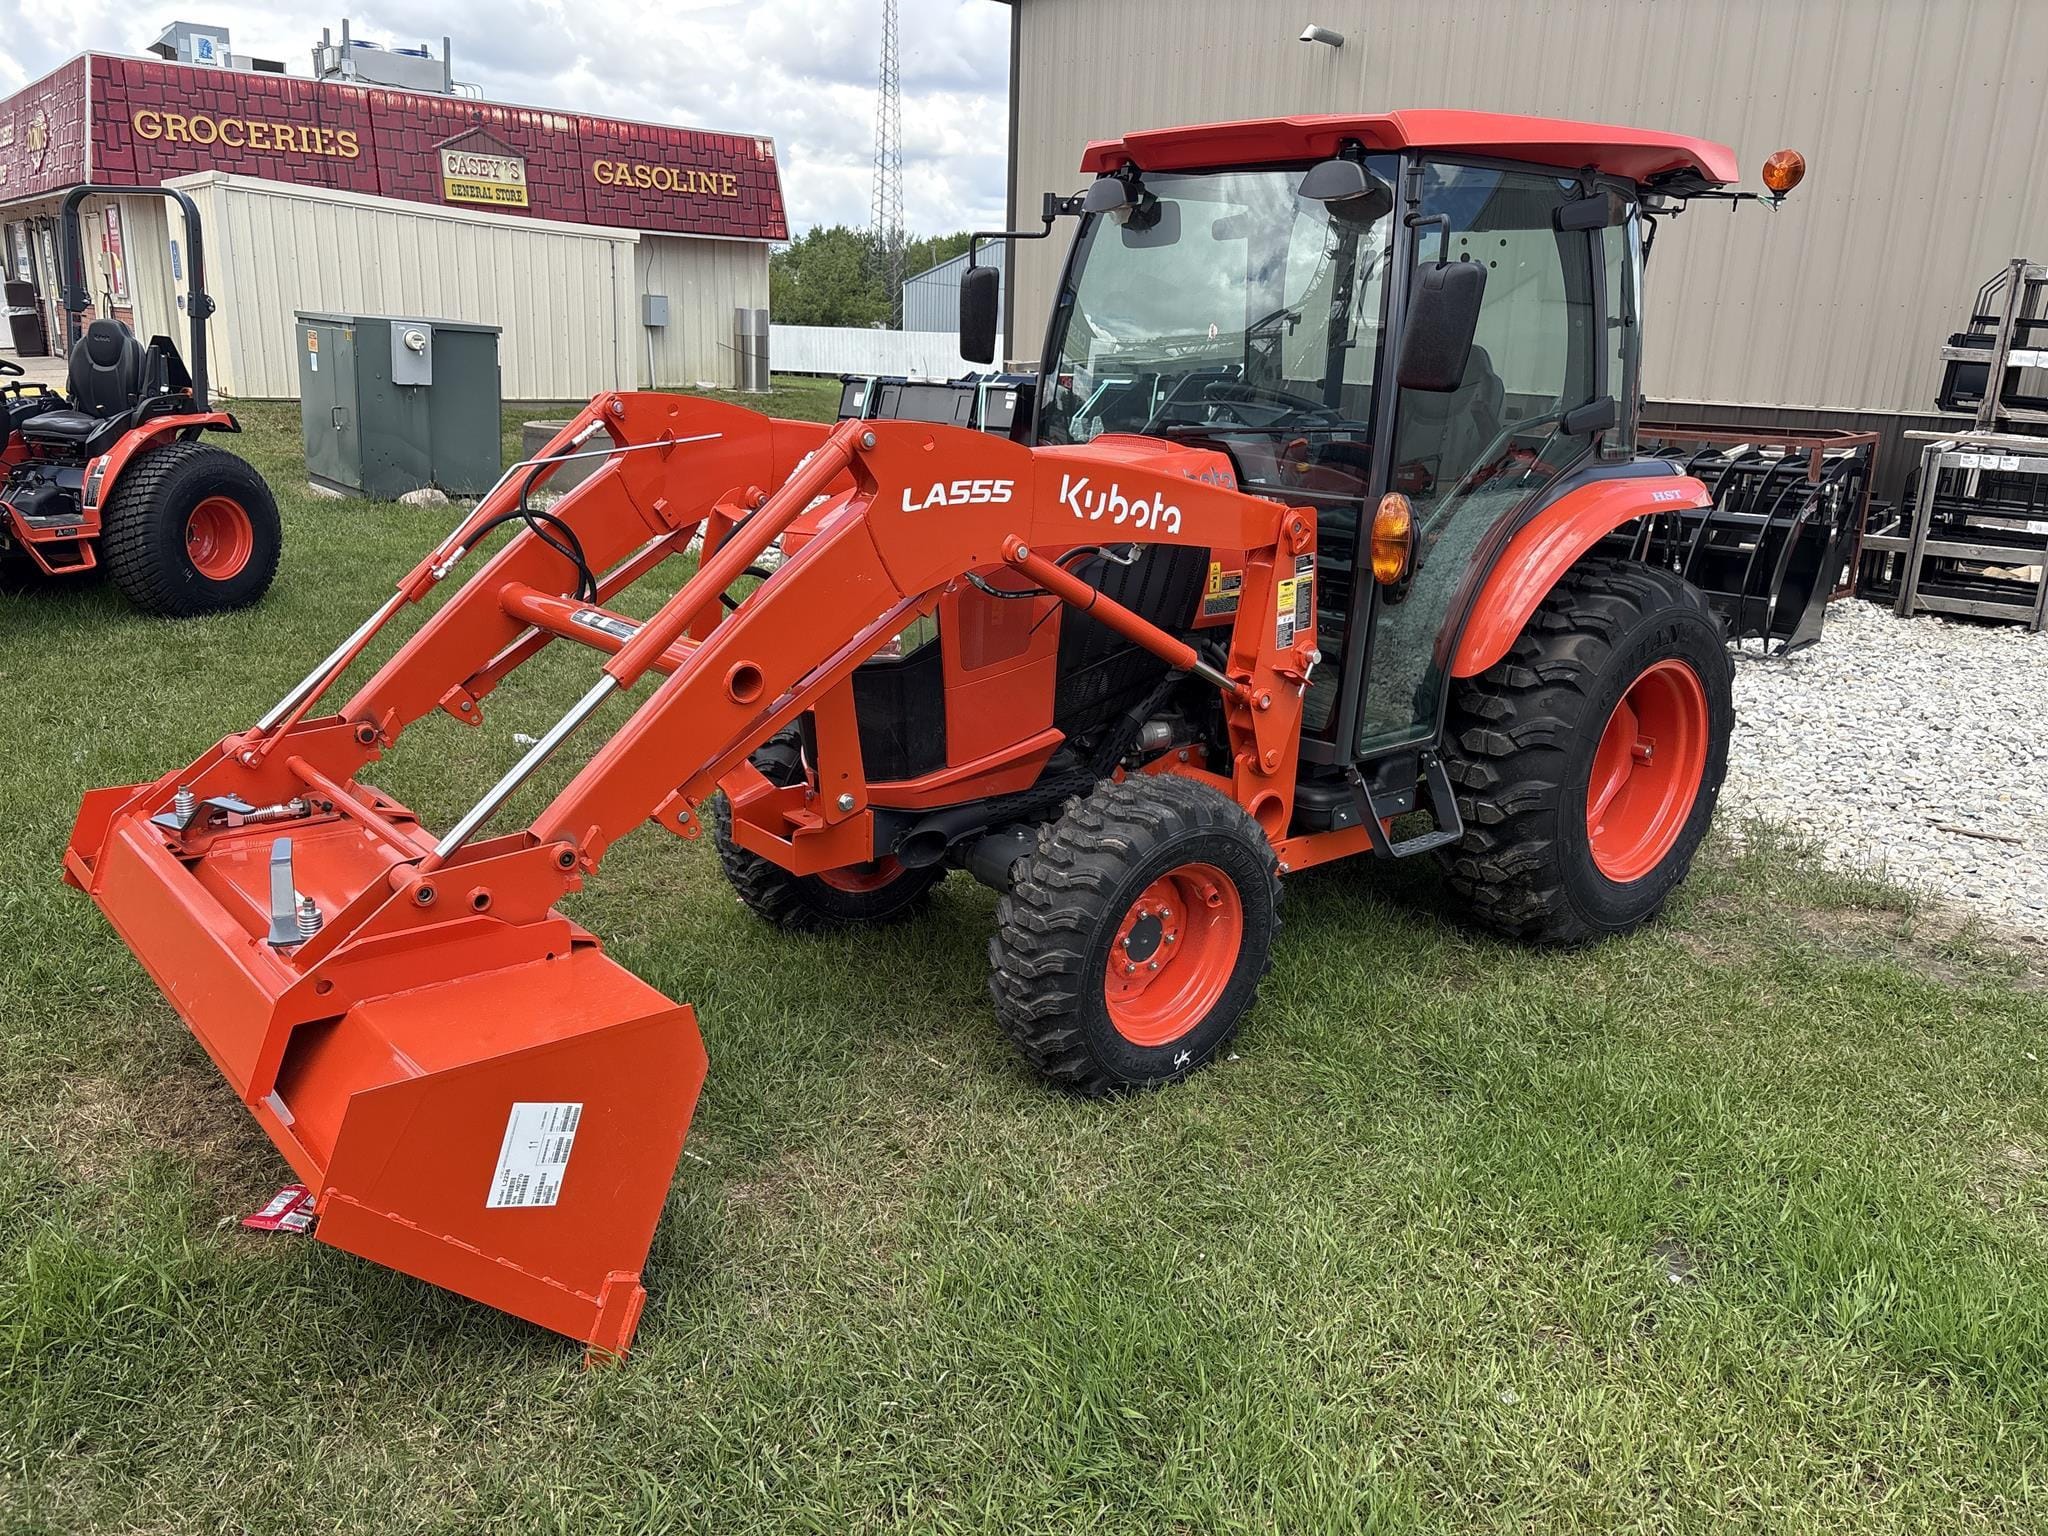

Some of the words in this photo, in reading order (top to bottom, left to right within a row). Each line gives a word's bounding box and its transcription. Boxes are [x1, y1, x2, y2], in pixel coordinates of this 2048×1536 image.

[133, 109, 360, 158] GROCERIES
[447, 155, 520, 180] CASEY'S
[593, 159, 738, 196] GASOLINE
[451, 183, 493, 200] GENERAL
[495, 188, 523, 203] STORE
[901, 479, 1015, 513] LA555
[1059, 473, 1182, 534] Kubota
[1652, 489, 1682, 502] HST
